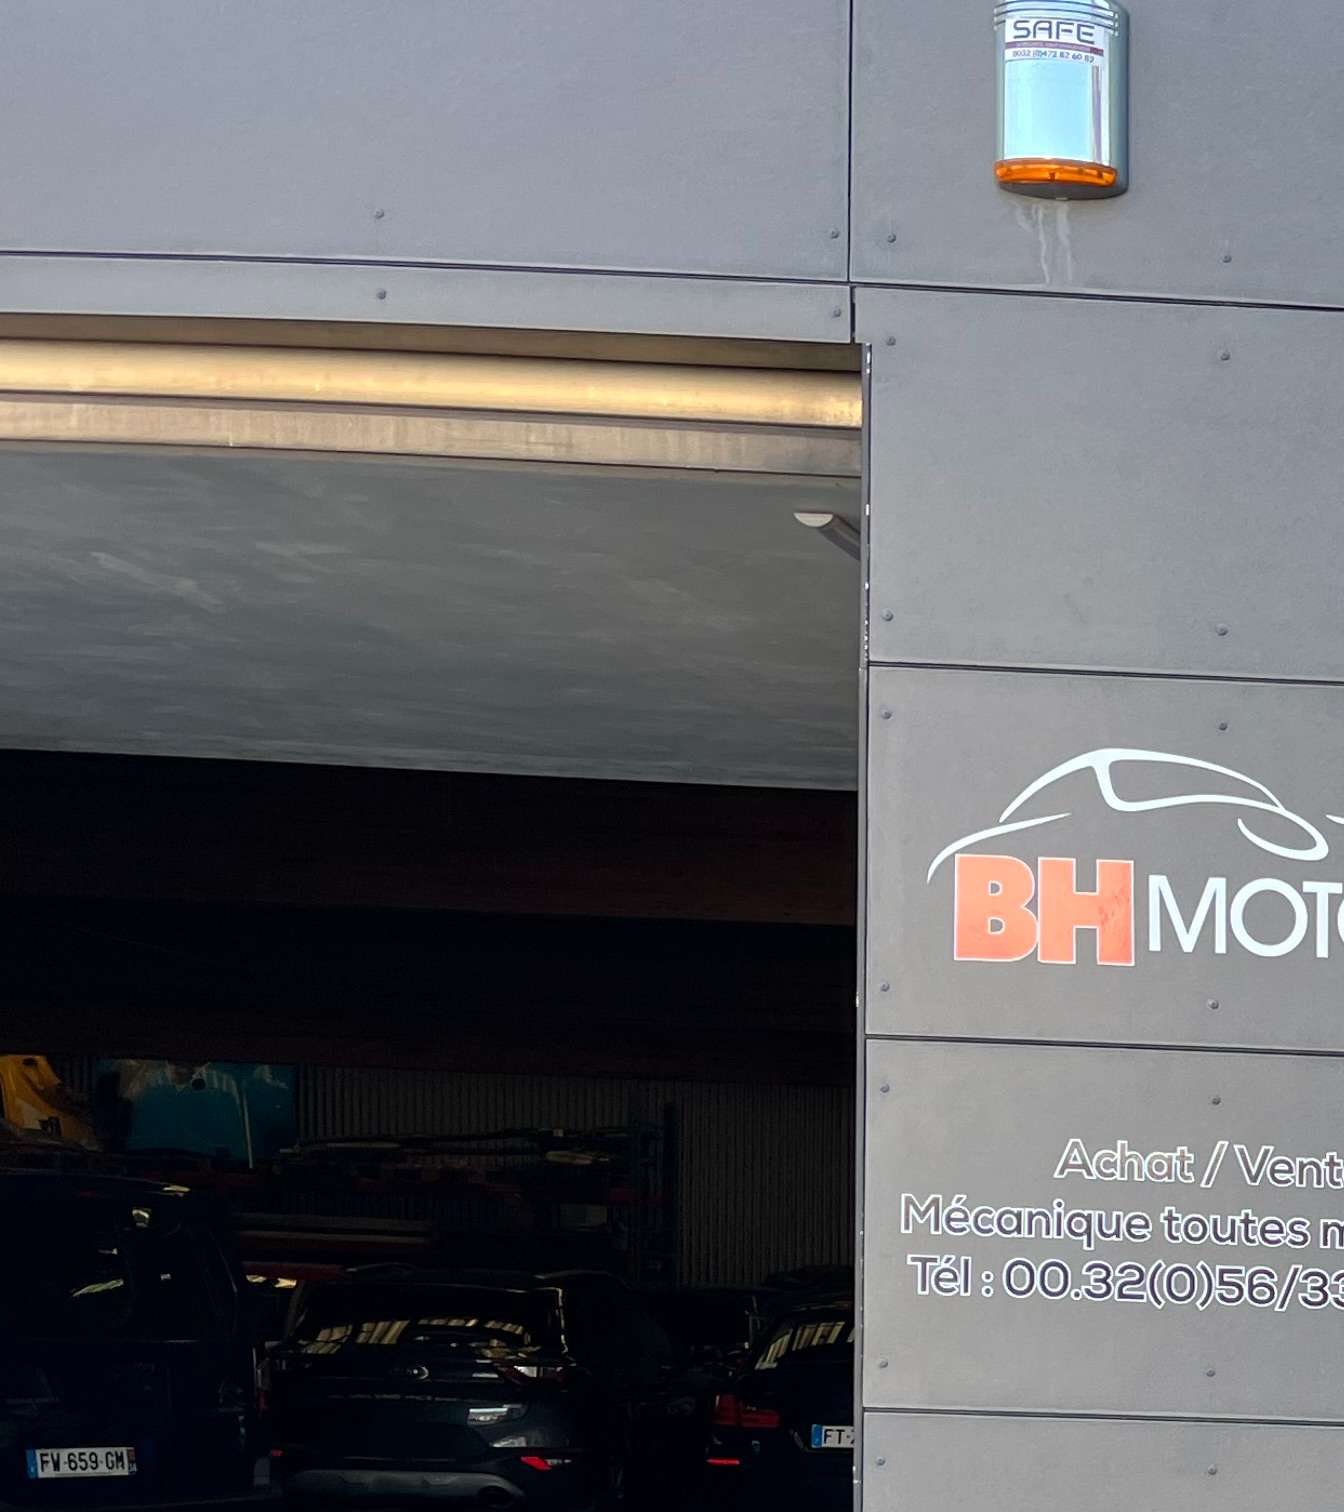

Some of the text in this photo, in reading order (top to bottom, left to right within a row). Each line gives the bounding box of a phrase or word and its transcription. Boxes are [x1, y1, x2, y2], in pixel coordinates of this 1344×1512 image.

[1012, 20, 1096, 45] SAFE
[953, 853, 1136, 967] BH
[1053, 1138, 1195, 1185] Achat
[900, 1194, 1152, 1250] Mécanique
[1161, 1206, 1310, 1248] toutes
